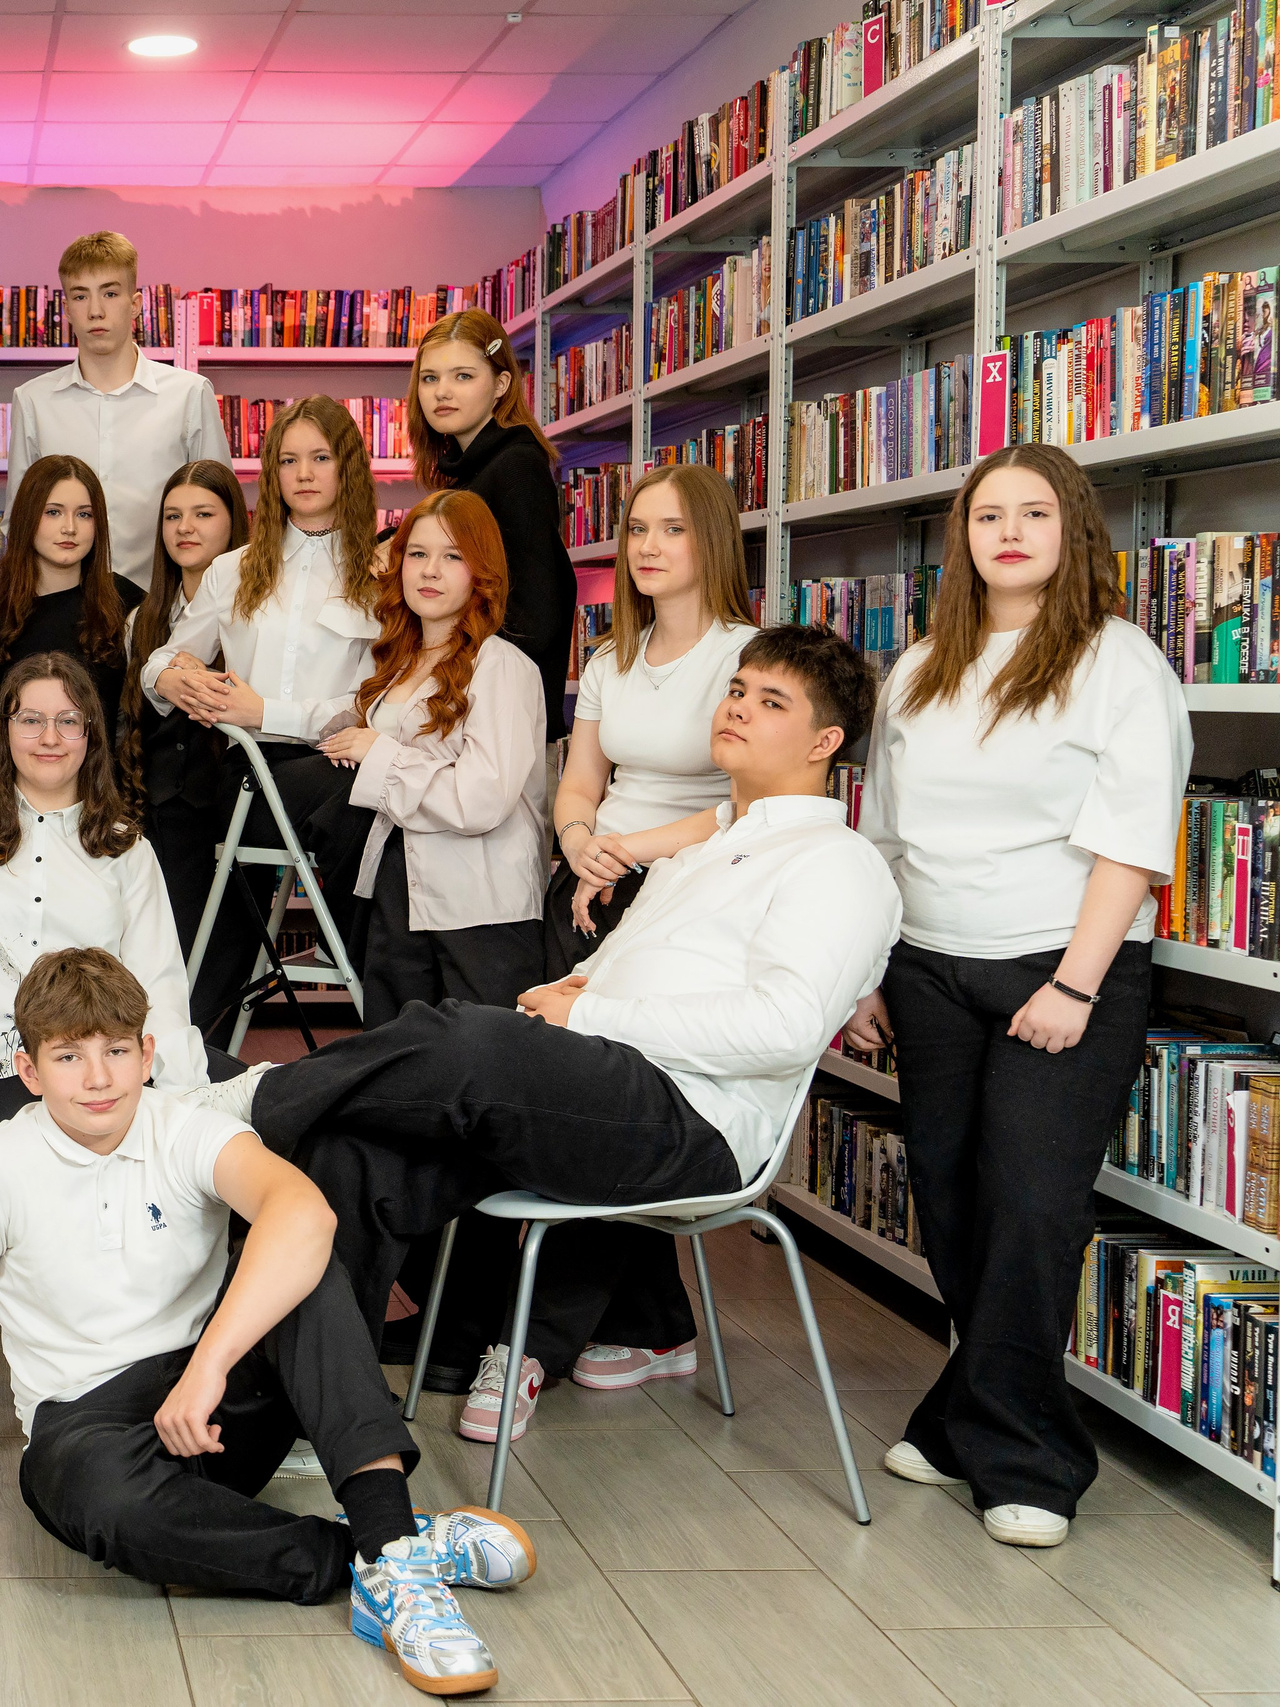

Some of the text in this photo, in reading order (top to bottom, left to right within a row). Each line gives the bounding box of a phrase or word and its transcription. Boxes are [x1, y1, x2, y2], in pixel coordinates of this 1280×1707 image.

[1227, 290, 1236, 319] ТОМАС
[1170, 309, 1180, 381] ТЕМНЫЕ ЗАВЕСЫ
[1226, 320, 1235, 349] ХАРРИС
[986, 361, 1003, 384] Х
[1044, 372, 1053, 423] ХАЙНЛАЙН
[1134, 375, 1143, 409] БАРХАТ
[887, 398, 895, 476] СГОРАЯ ДОТЛА
[1032, 411, 1041, 443] АТРИЦИЯ
[1140, 599, 1148, 630] ПРОПАВ
[1150, 598, 1158, 634] ЯНТАРНЫЕ
[1239, 577, 1251, 674] ДЕВУШКА В ПОЕЗДЕ
[1192, 855, 1199, 868] НА
[151, 1222, 168, 1232] USPA
[1182, 1267, 1196, 1321] ДЕРЕВЬЕВ
[1166, 1304, 1181, 1330] Я
[1181, 1324, 1195, 1360] СРЕДИ
[1266, 1333, 1275, 1353] Туве
[1181, 1359, 1195, 1394] ЛЮДИ
